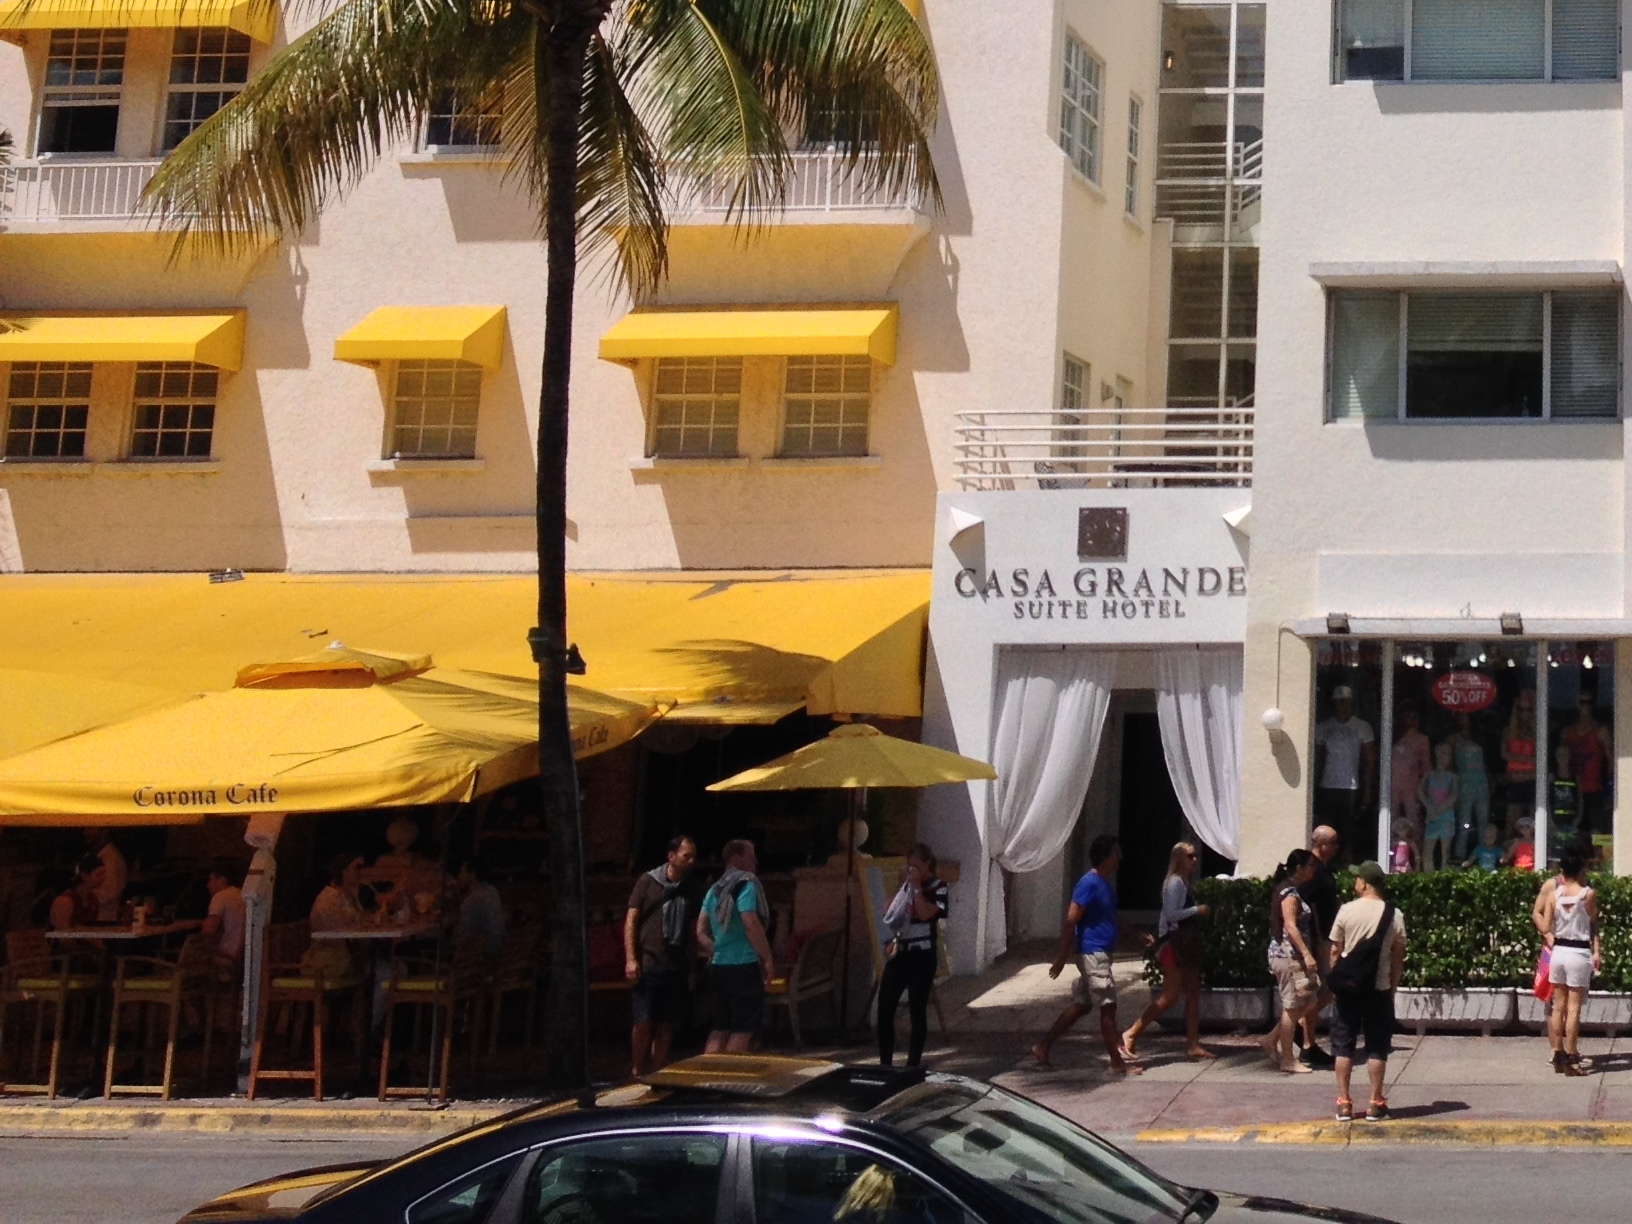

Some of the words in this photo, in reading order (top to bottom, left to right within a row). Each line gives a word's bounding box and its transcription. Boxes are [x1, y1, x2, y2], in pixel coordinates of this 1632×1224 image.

[954, 567, 1057, 598] CASA
[1073, 566, 1247, 597] GRANDE
[1013, 599, 1089, 619] SUITE
[1102, 599, 1186, 619] HOTEL
[133, 786, 217, 807] Corona
[225, 783, 279, 805] Cafe
